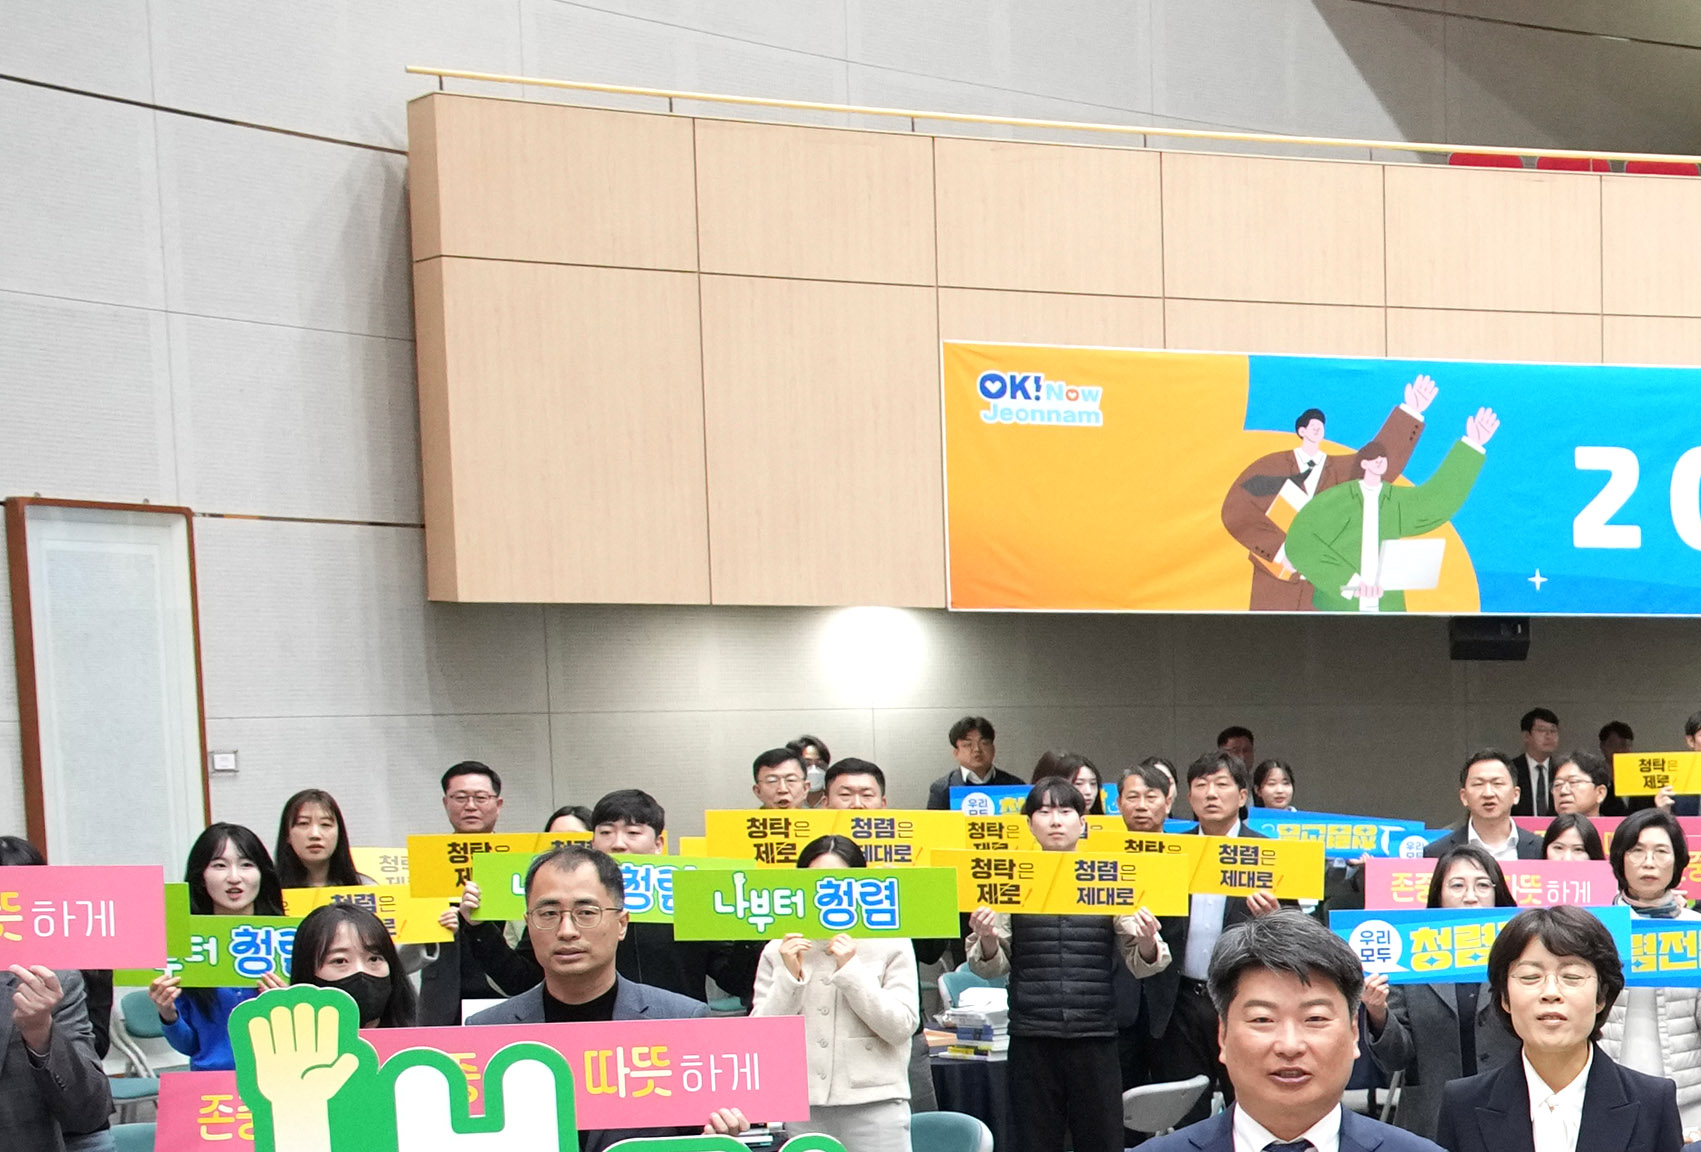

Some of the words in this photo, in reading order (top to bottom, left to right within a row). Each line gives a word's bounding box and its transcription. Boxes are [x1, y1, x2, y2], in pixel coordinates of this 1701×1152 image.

[979, 373, 1042, 402] OK!
[983, 403, 1101, 424] Jeonnam
[1638, 757, 1678, 772] 청탁은
[967, 797, 989, 808] 우리
[746, 817, 811, 839] 청탁은
[851, 817, 914, 840] 청렴은
[967, 821, 1020, 840] 청탁은
[753, 841, 798, 865] 제로
[1219, 843, 1276, 866] 청렴은
[971, 857, 1035, 881] 청탁은
[1074, 860, 1137, 883] 청렴은
[1076, 887, 1146, 909] 제대로!
[1505, 872, 1591, 905] 뜻하게
[713, 871, 806, 934] 나부터
[814, 876, 900, 931] 청렴
[0, 891, 116, 942] 뜻하게
[1359, 929, 1391, 945] 우리
[1410, 921, 1500, 972] 청렴
[1360, 948, 1392, 964] 모두
[584, 1045, 760, 1099] 따뜻하게
